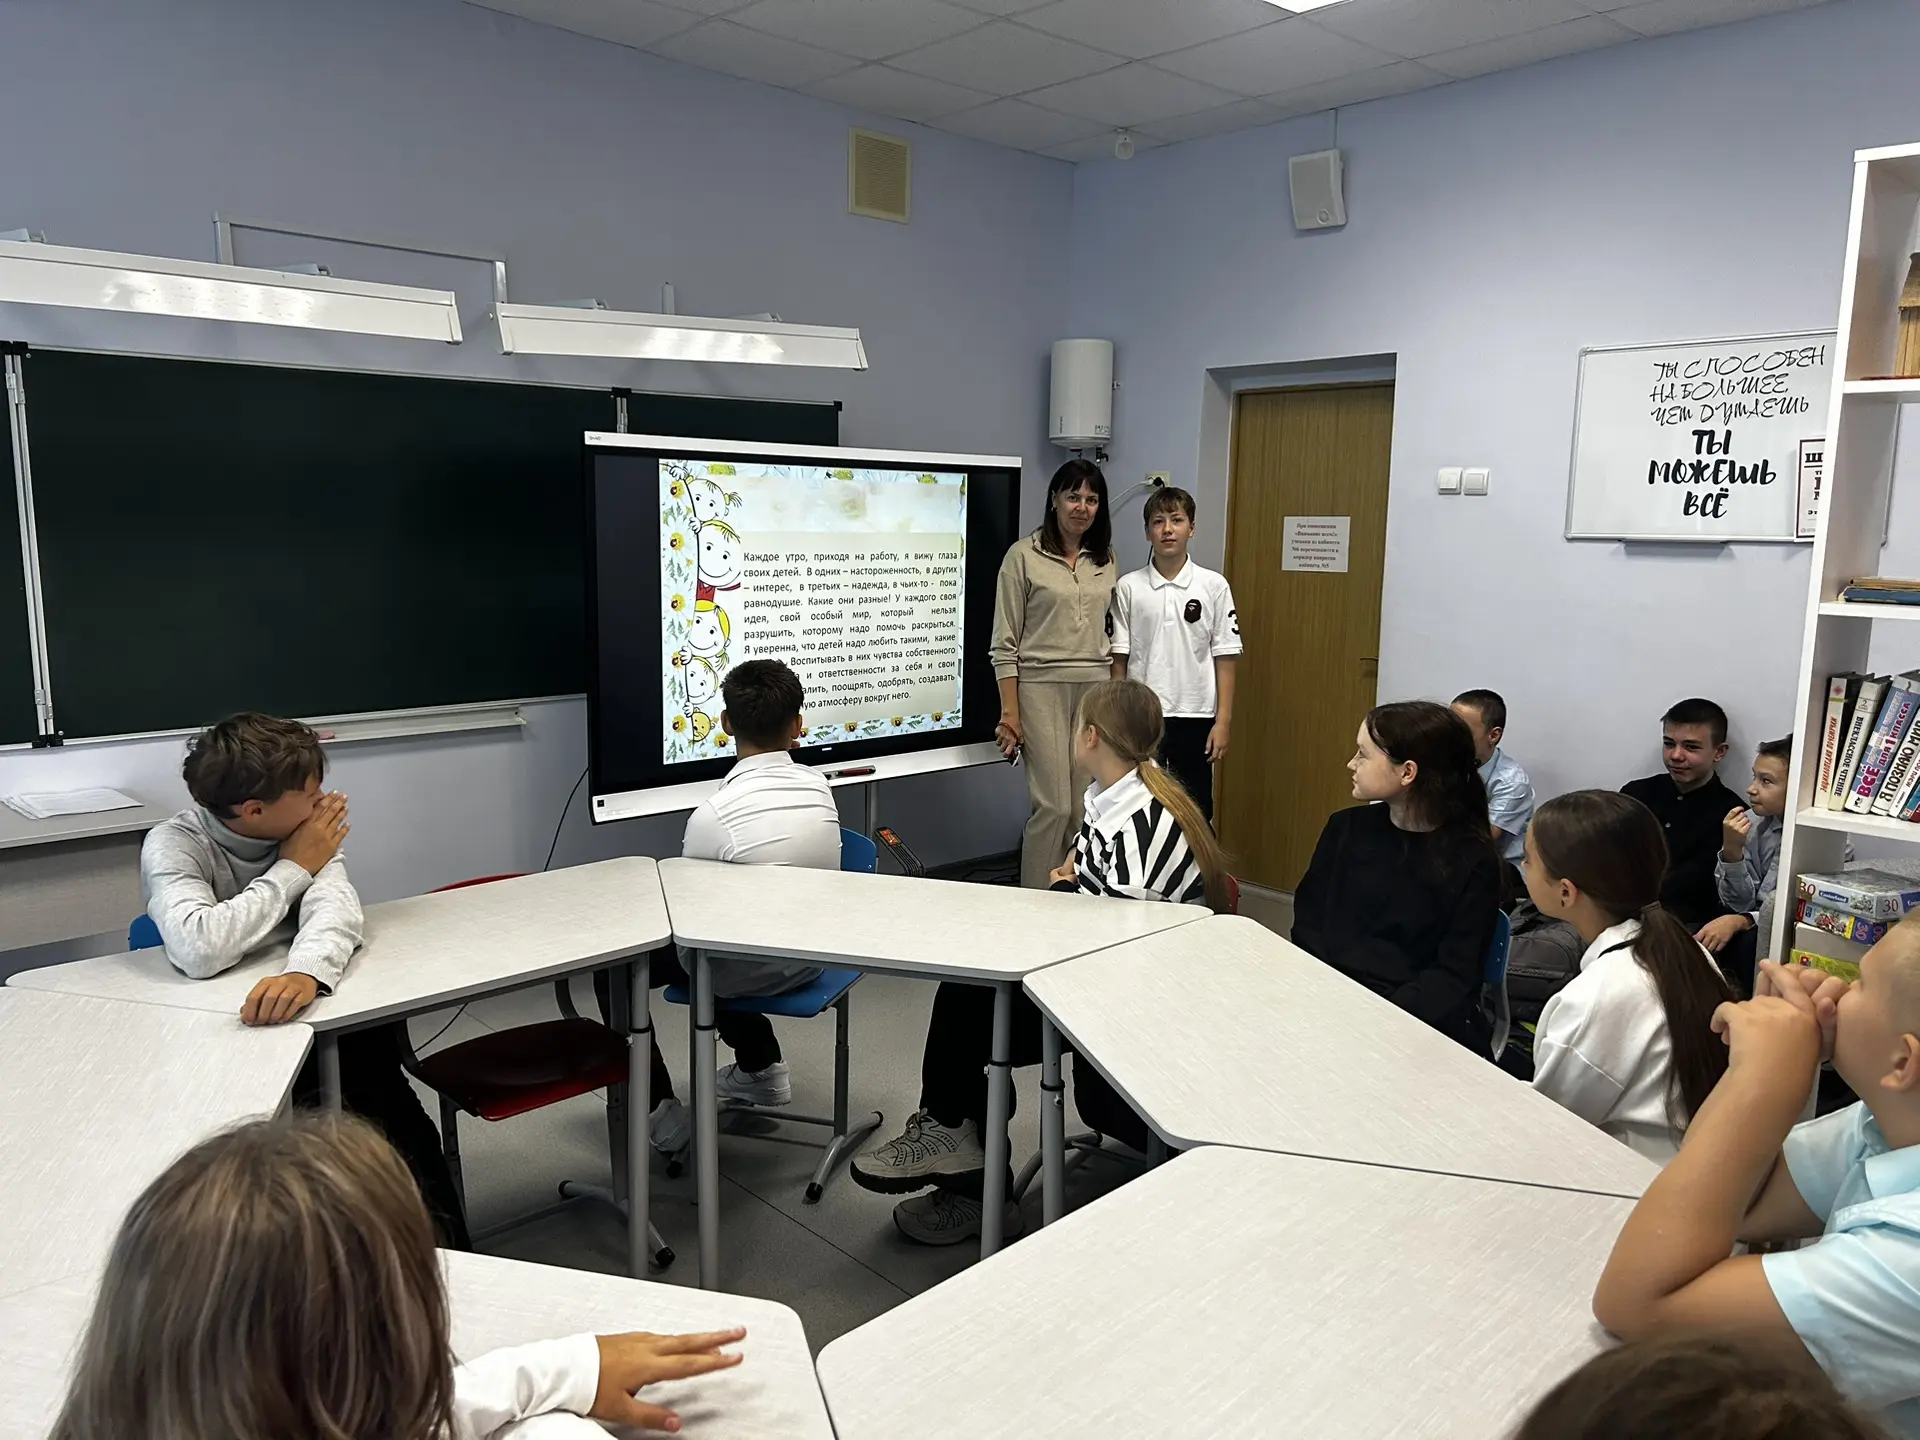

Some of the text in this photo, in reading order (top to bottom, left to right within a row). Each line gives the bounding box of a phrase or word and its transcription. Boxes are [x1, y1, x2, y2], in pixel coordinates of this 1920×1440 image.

[1654, 345, 1825, 382] ТЫ СПОСОБЕН
[1650, 383, 1677, 403] НА
[1650, 396, 1809, 426] ЧЕМ ДУМАЕШЬ
[1692, 429, 1732, 455] ТЫ
[1648, 458, 1776, 484] МОЖЕШЬ
[1683, 487, 1729, 518] ВСЁ
[744, 553, 779, 562] Каждое
[785, 554, 808, 562] утро,
[814, 554, 849, 562] приходя
[870, 551, 899, 562] работу,
[772, 567, 801, 578] детей.
[807, 567, 812, 576] В
[815, 568, 840, 577] одних
[851, 567, 922, 576] настороженность,
[932, 566, 958, 575] других
[753, 584, 792, 593] интерес,
[808, 583, 840, 592] третьих
[852, 582, 890, 590] надежда,
[744, 599, 803, 610] равнодушие.
[808, 597, 833, 605] Какие
[859, 594, 891, 605] разные!
[895, 594, 900, 602] У
[904, 594, 936, 602] каждого
[744, 615, 769, 624] идея,
[780, 612, 800, 622] свой
[811, 610, 843, 620] особый
[881, 607, 914, 618] который
[744, 630, 795, 640] разрушить,
[802, 627, 843, 636] которому
[912, 620, 956, 630] раскрыться.
[744, 645, 750, 654] Я
[753, 644, 798, 655] уверенна,
[818, 639, 843, 650] детей
[846, 640, 866, 648] надо
[868, 637, 898, 646] любить
[900, 636, 930, 644] такими,
[790, 655, 845, 666] Воспитывать
[874, 651, 902, 661] чувства
[905, 647, 956, 657] собственного
[818, 666, 885, 678] ответственности
[905, 662, 922, 671] себя
[803, 674, 955, 694] алить, поощрять, одобрять, создавать
[818, 695, 862, 707] атмосферу
[865, 693, 890, 702] вокруг
[892, 692, 911, 700] него.
[1843, 716, 1864, 768] ВНЕКЛАССНОЕ
[1878, 746, 1891, 765] ДЛЯ
[1890, 702, 1912, 738] КЛАССА
[1885, 746, 1914, 792] ПОЗНАЮ
[1834, 769, 1848, 797] ЧТЕНИЕ
[1857, 764, 1880, 798] ВСЁ
[1880, 792, 1893, 801] Я
[1883, 899, 1899, 912] 30
